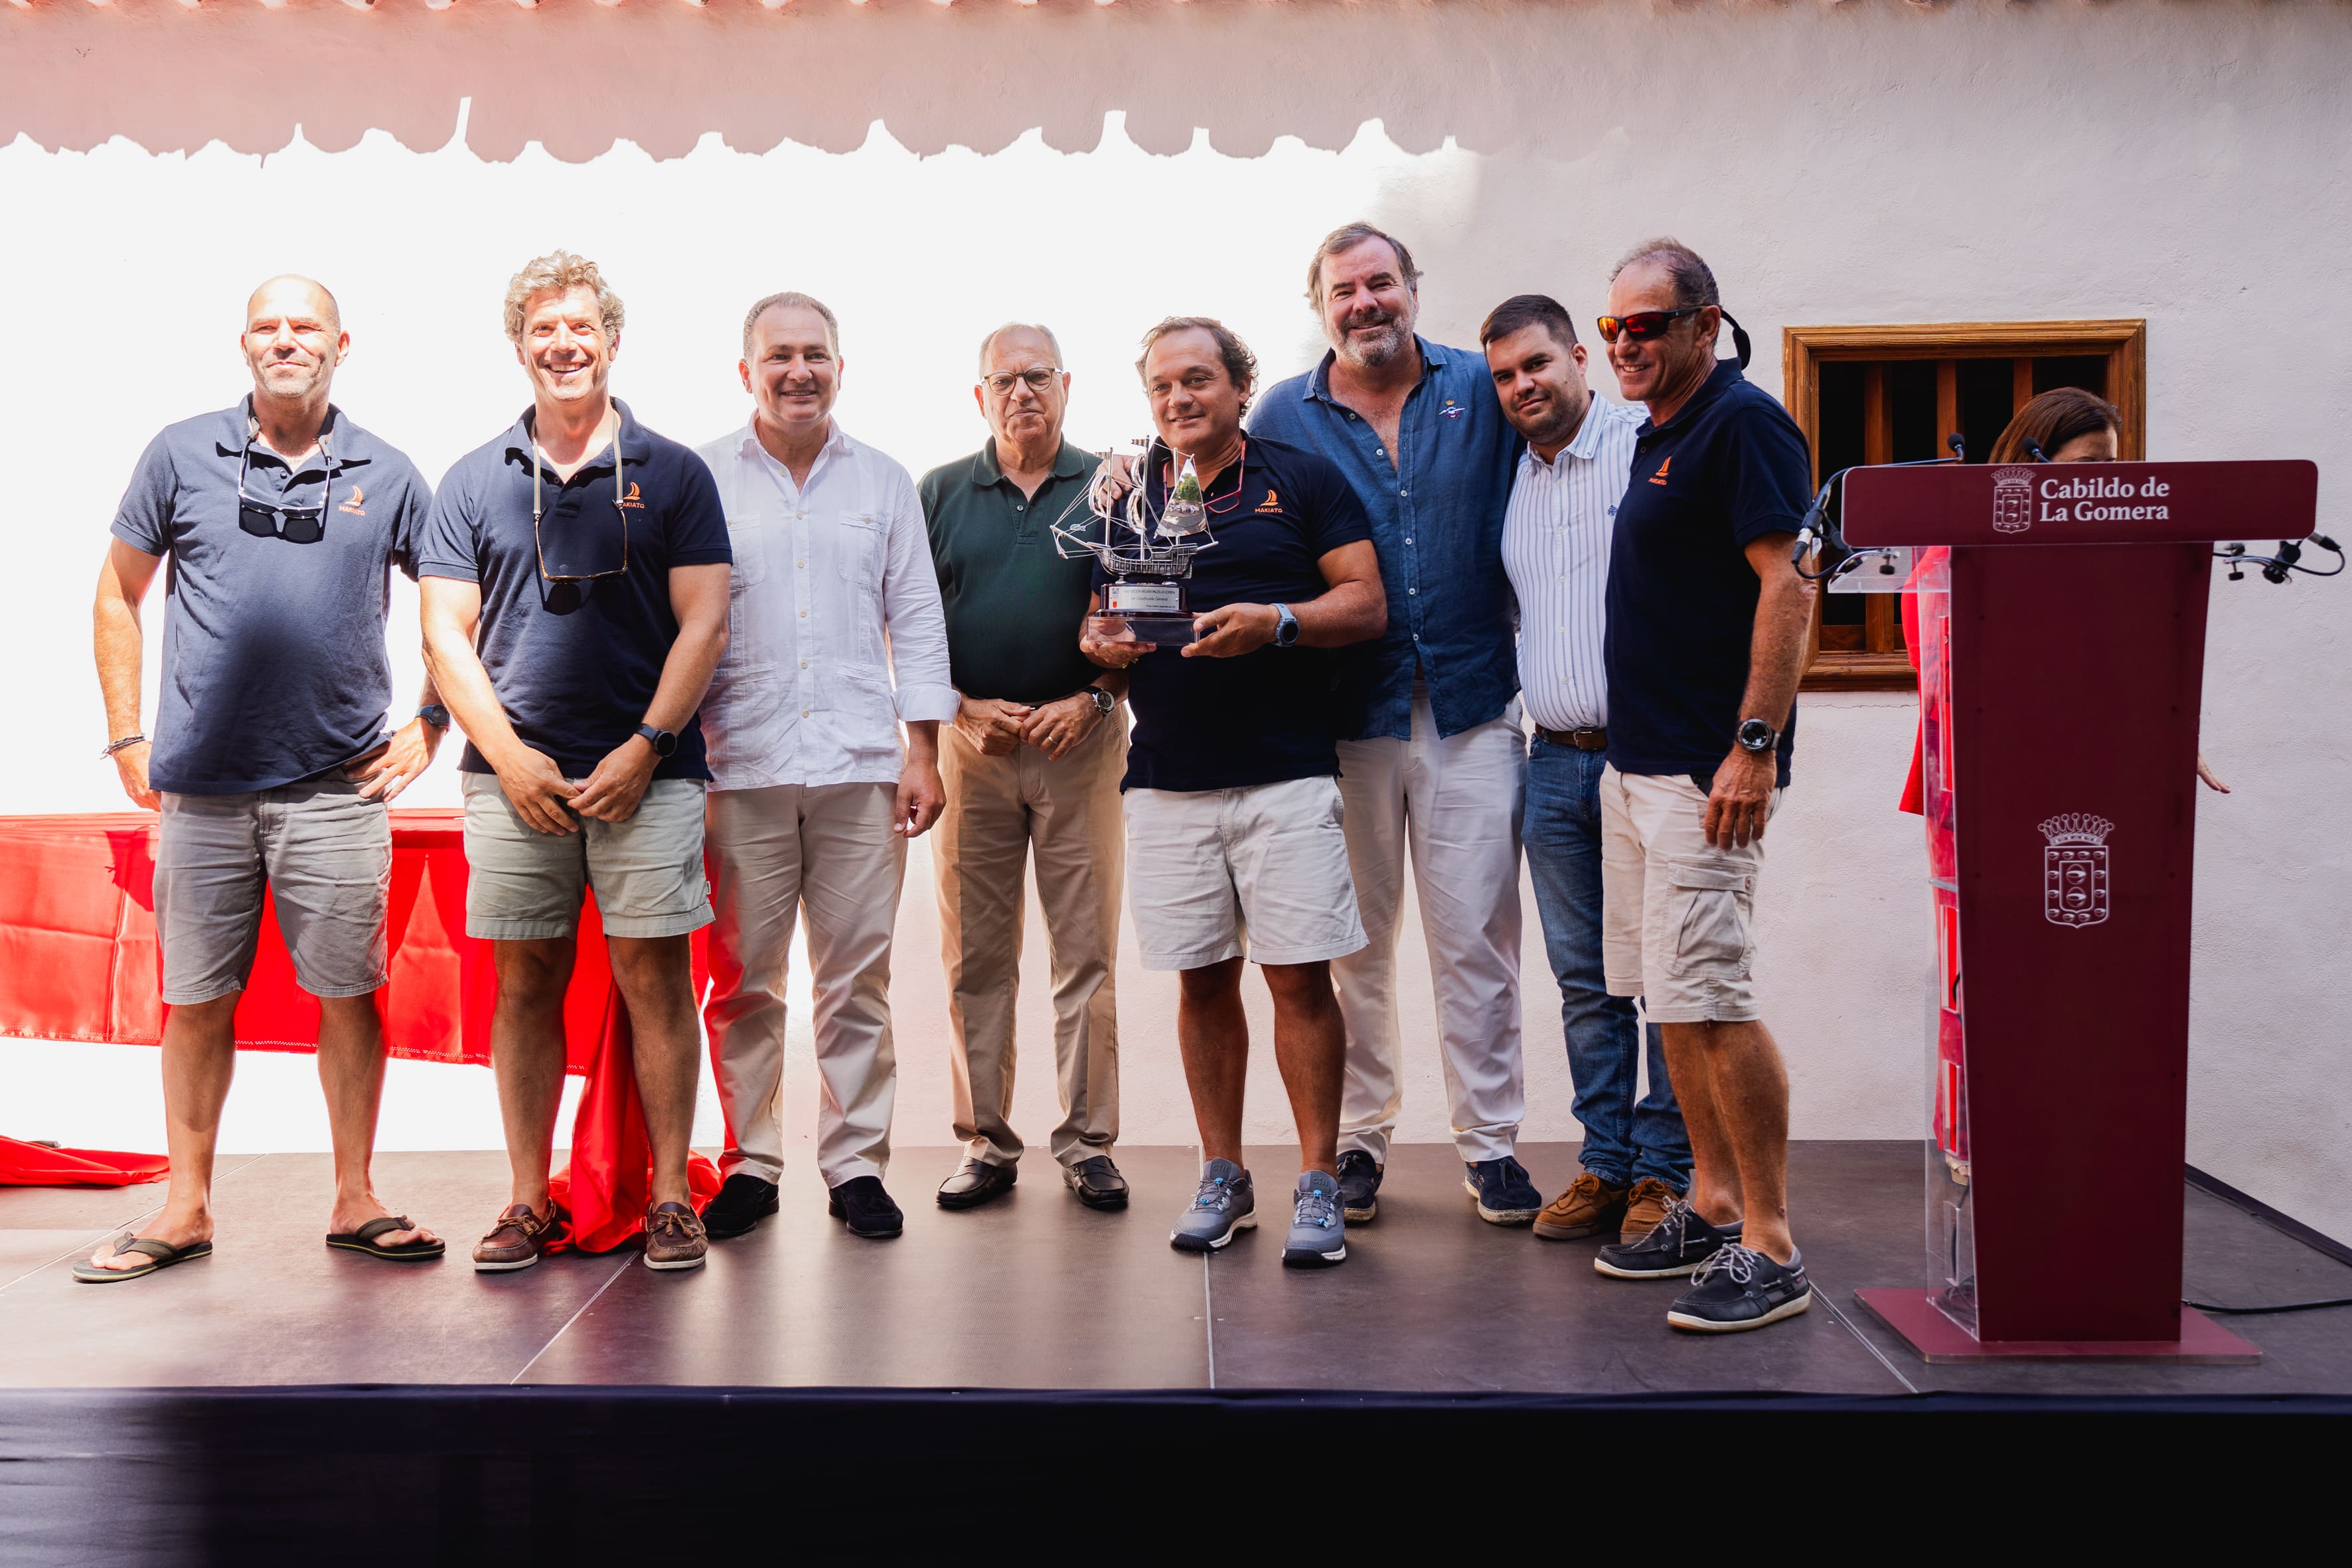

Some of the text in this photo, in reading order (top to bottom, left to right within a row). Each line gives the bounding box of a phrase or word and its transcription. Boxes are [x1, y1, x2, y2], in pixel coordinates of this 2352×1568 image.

[2040, 476, 2170, 499] Cabildo de
[339, 506, 365, 516] MAKIATO
[2039, 501, 2169, 521] La Gomera
